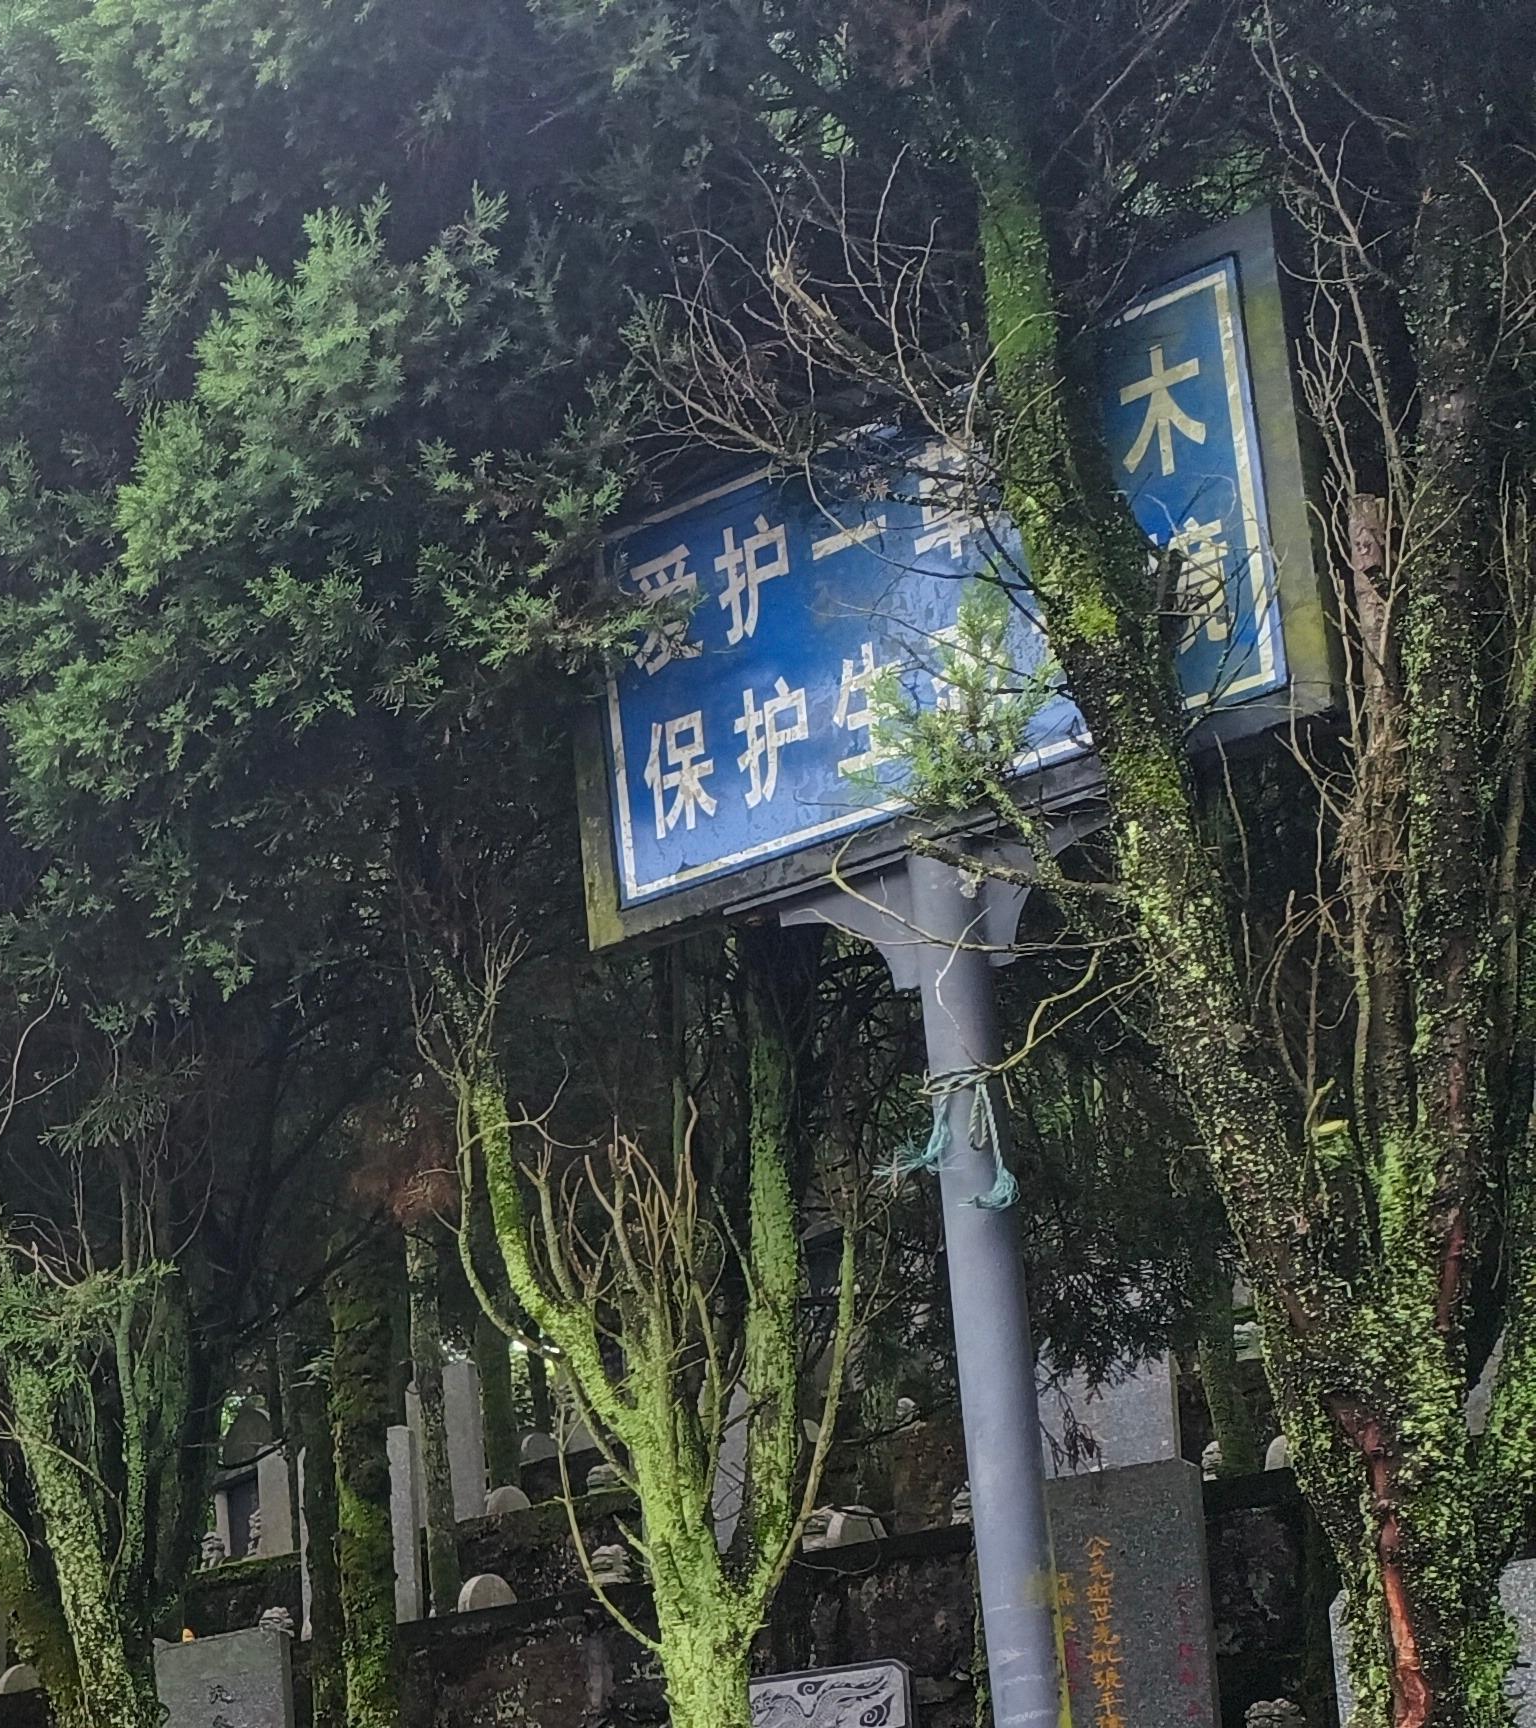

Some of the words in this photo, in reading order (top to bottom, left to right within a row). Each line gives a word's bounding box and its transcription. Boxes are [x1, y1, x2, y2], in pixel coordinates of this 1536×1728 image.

[630, 346, 1207, 677] 爱护一草木
[644, 518, 1231, 840] 保护生境
